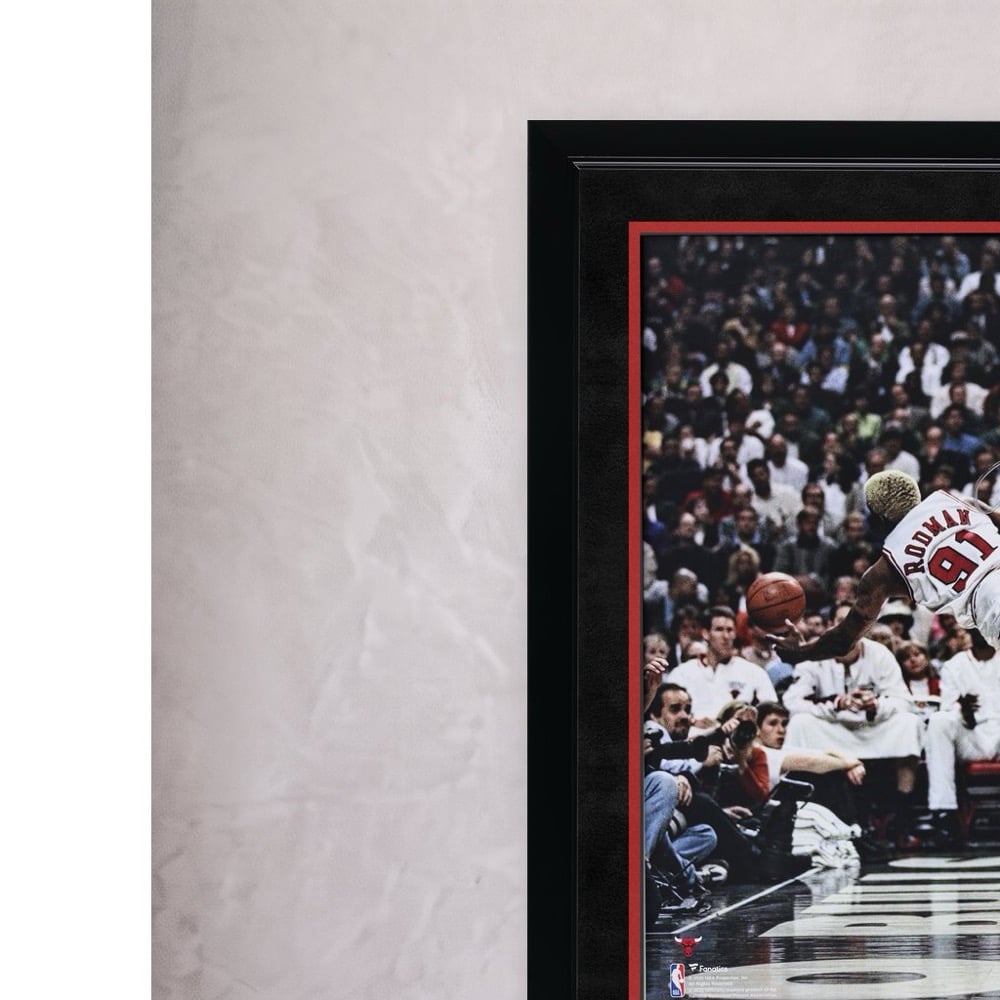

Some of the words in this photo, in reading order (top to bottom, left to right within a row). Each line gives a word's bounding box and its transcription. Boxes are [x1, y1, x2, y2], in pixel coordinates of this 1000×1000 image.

[904, 508, 971, 576] RODMAN
[928, 529, 998, 594] 91
[699, 965, 729, 973] Fanatics
